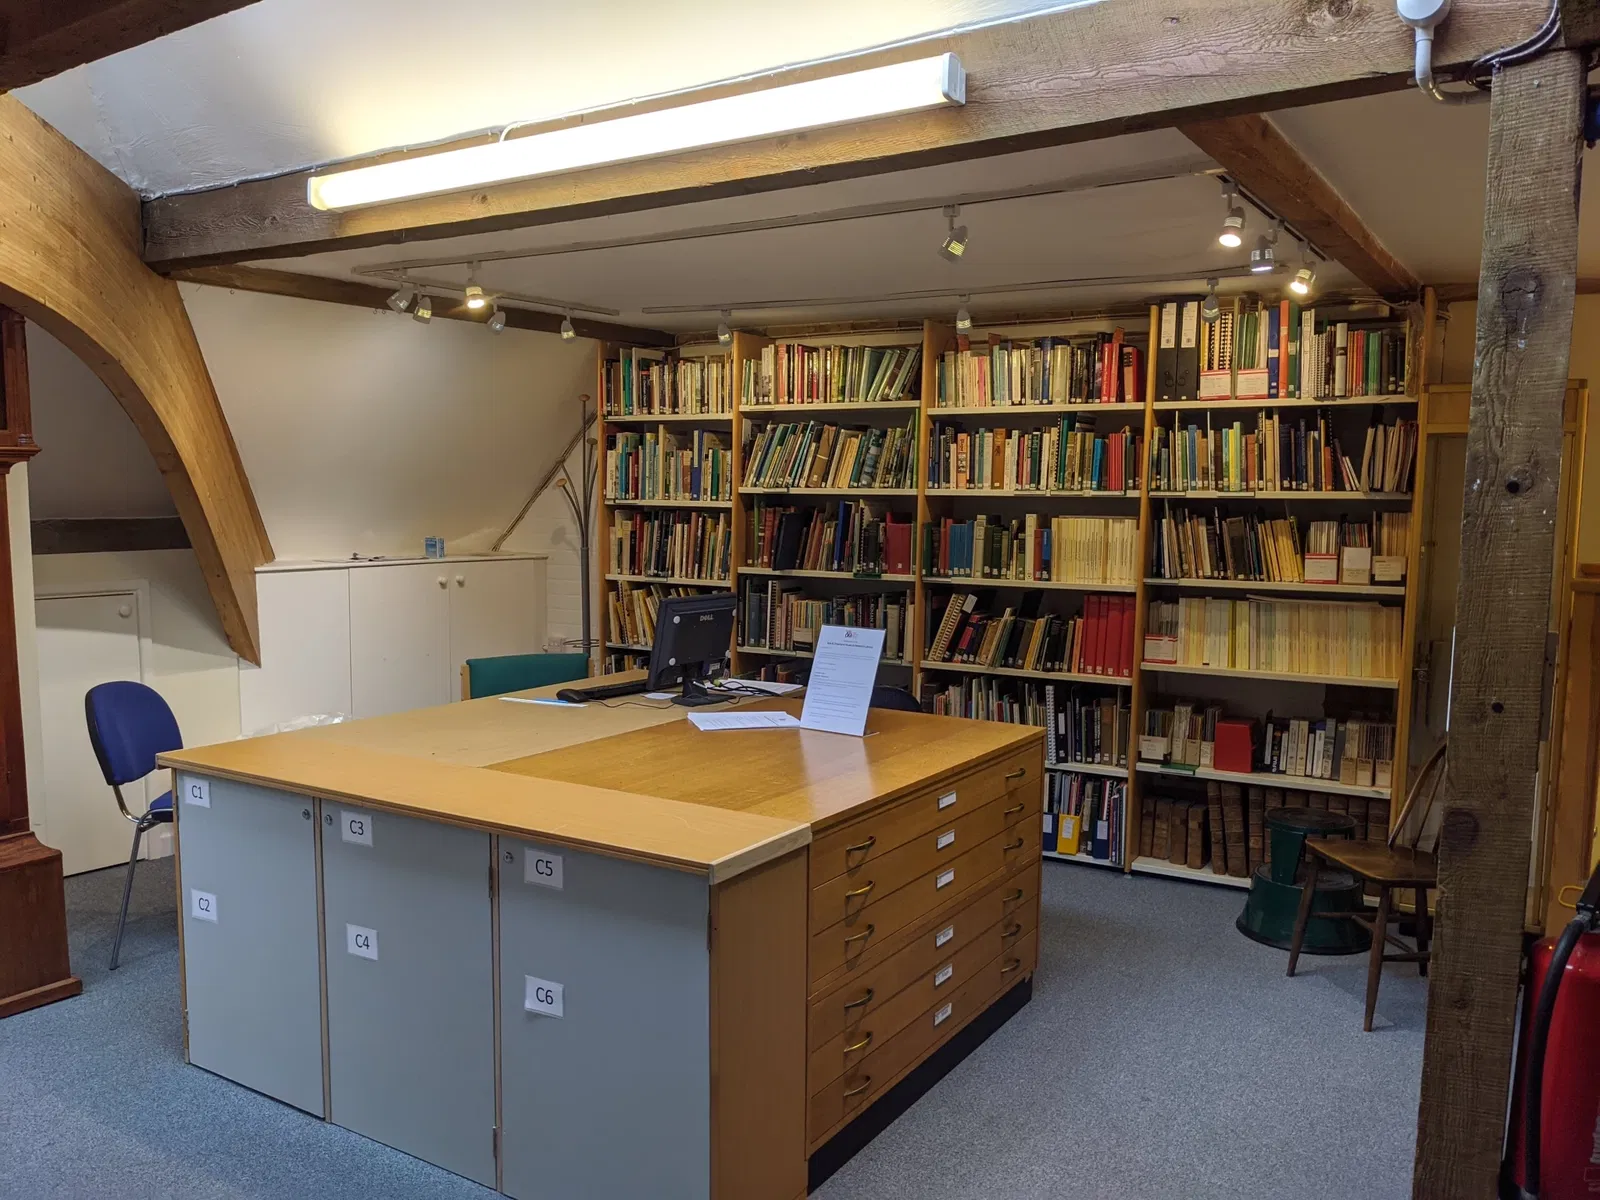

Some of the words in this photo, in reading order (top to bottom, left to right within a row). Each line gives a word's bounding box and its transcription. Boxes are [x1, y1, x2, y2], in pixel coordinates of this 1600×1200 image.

[699, 613, 715, 622] DELL
[191, 785, 204, 800] C1
[349, 820, 364, 836] C3
[535, 858, 553, 877] C5
[198, 897, 211, 913] C2
[355, 933, 370, 950] C4
[535, 986, 554, 1006] C6
